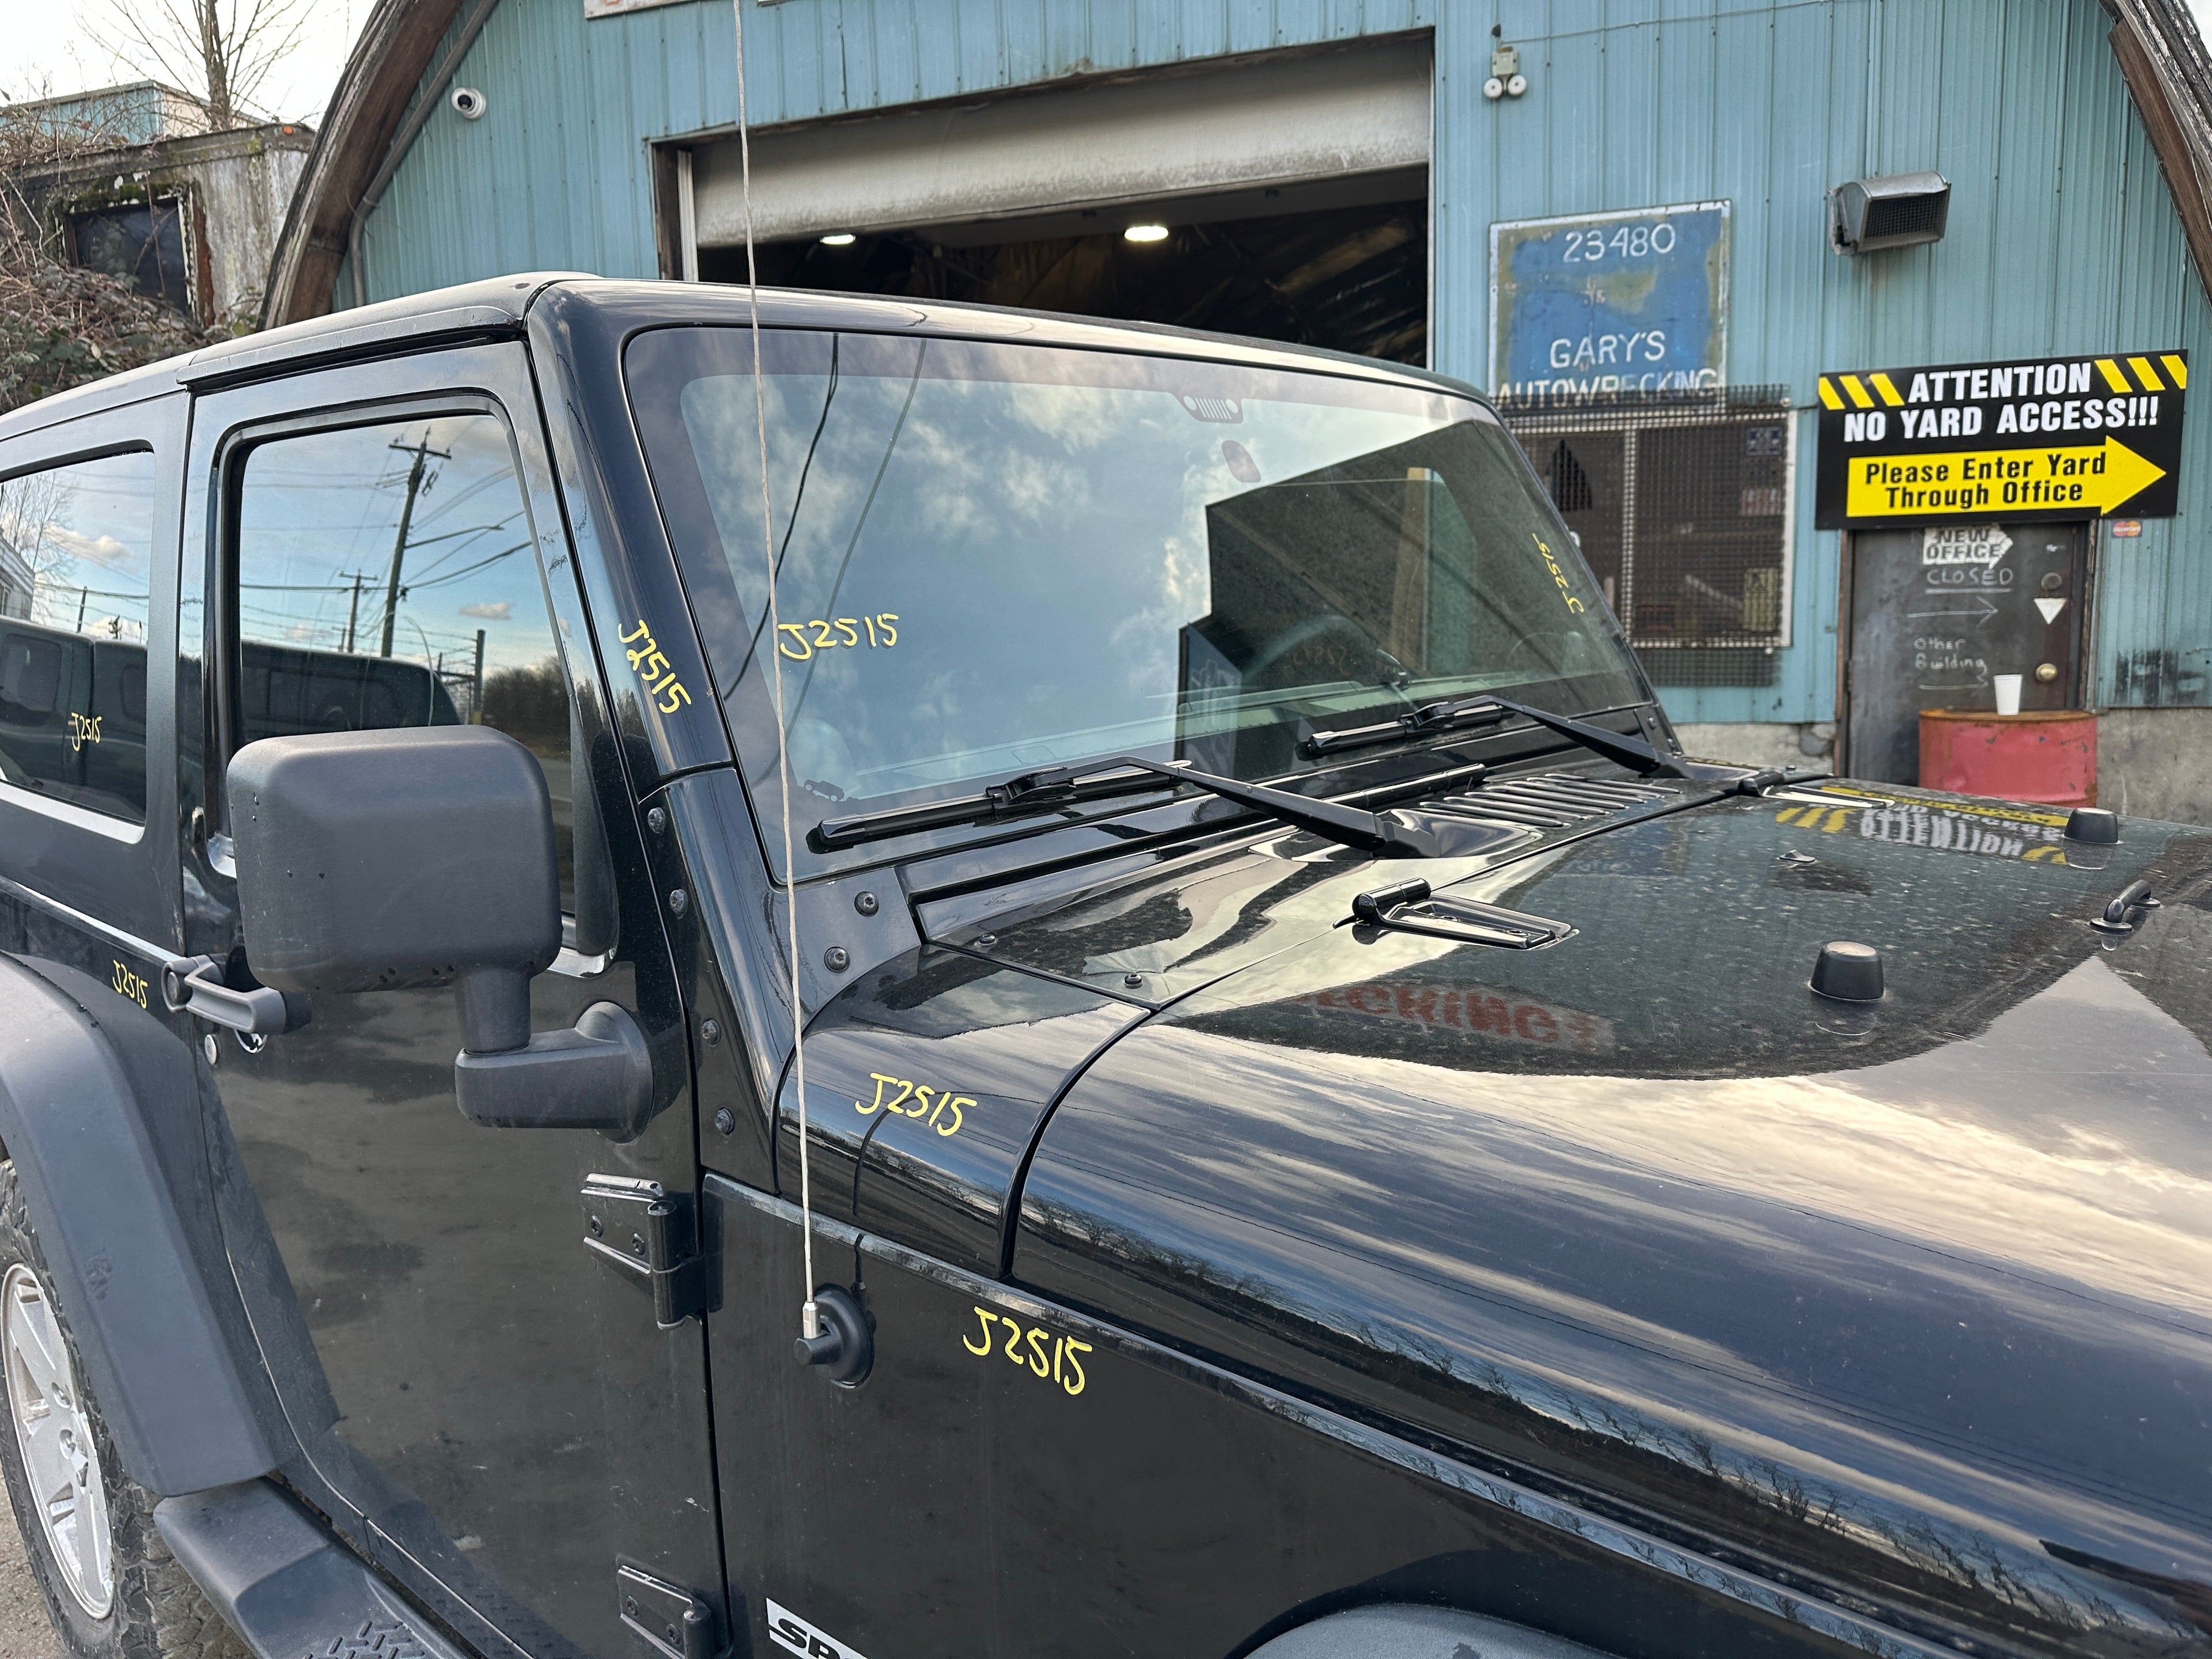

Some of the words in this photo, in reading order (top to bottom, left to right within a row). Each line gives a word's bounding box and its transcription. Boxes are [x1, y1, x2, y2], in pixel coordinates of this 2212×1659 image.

[1563, 224, 1675, 262] 23480
[1550, 330, 1666, 369] GARY'S
[1908, 363, 2090, 402] ATTENTION
[1844, 412, 1887, 443] NO
[1900, 405, 1983, 439] YARD
[1996, 396, 2158, 434] ACCESS!!!
[1865, 461, 1949, 484] Please
[1963, 457, 2034, 480] Enter
[2047, 452, 2107, 475] Yard
[1885, 485, 1990, 510] Through
[2002, 480, 2084, 503] Office
[1926, 543, 2003, 559] OFFICE
[1938, 528, 1990, 543] NEW
[1926, 567, 2014, 585] CLOSED
[768, 1618, 854, 1659] SP
